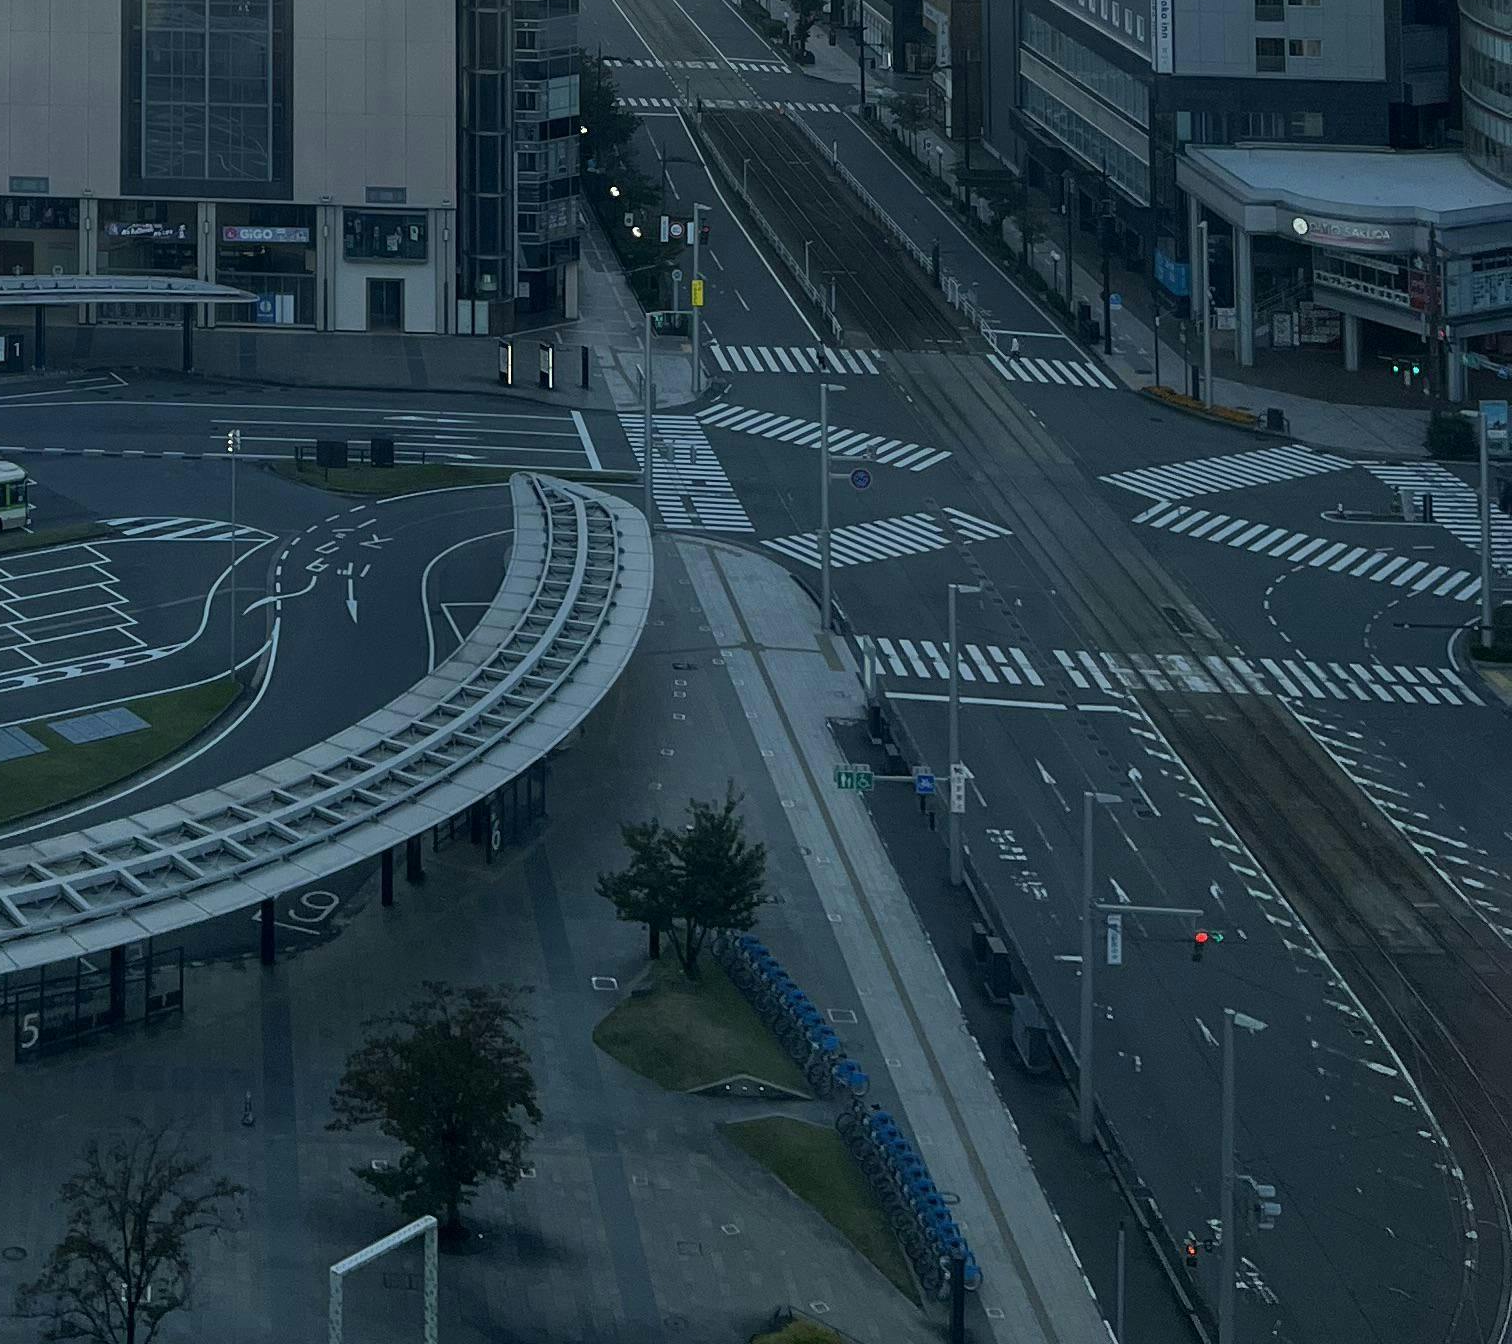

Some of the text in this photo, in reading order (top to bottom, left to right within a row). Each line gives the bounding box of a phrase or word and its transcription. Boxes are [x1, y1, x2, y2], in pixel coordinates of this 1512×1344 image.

[240, 228, 273, 240] GiGO
[14, 342, 20, 357] 1
[491, 818, 501, 851] 6
[21, 1012, 39, 1049] 5
